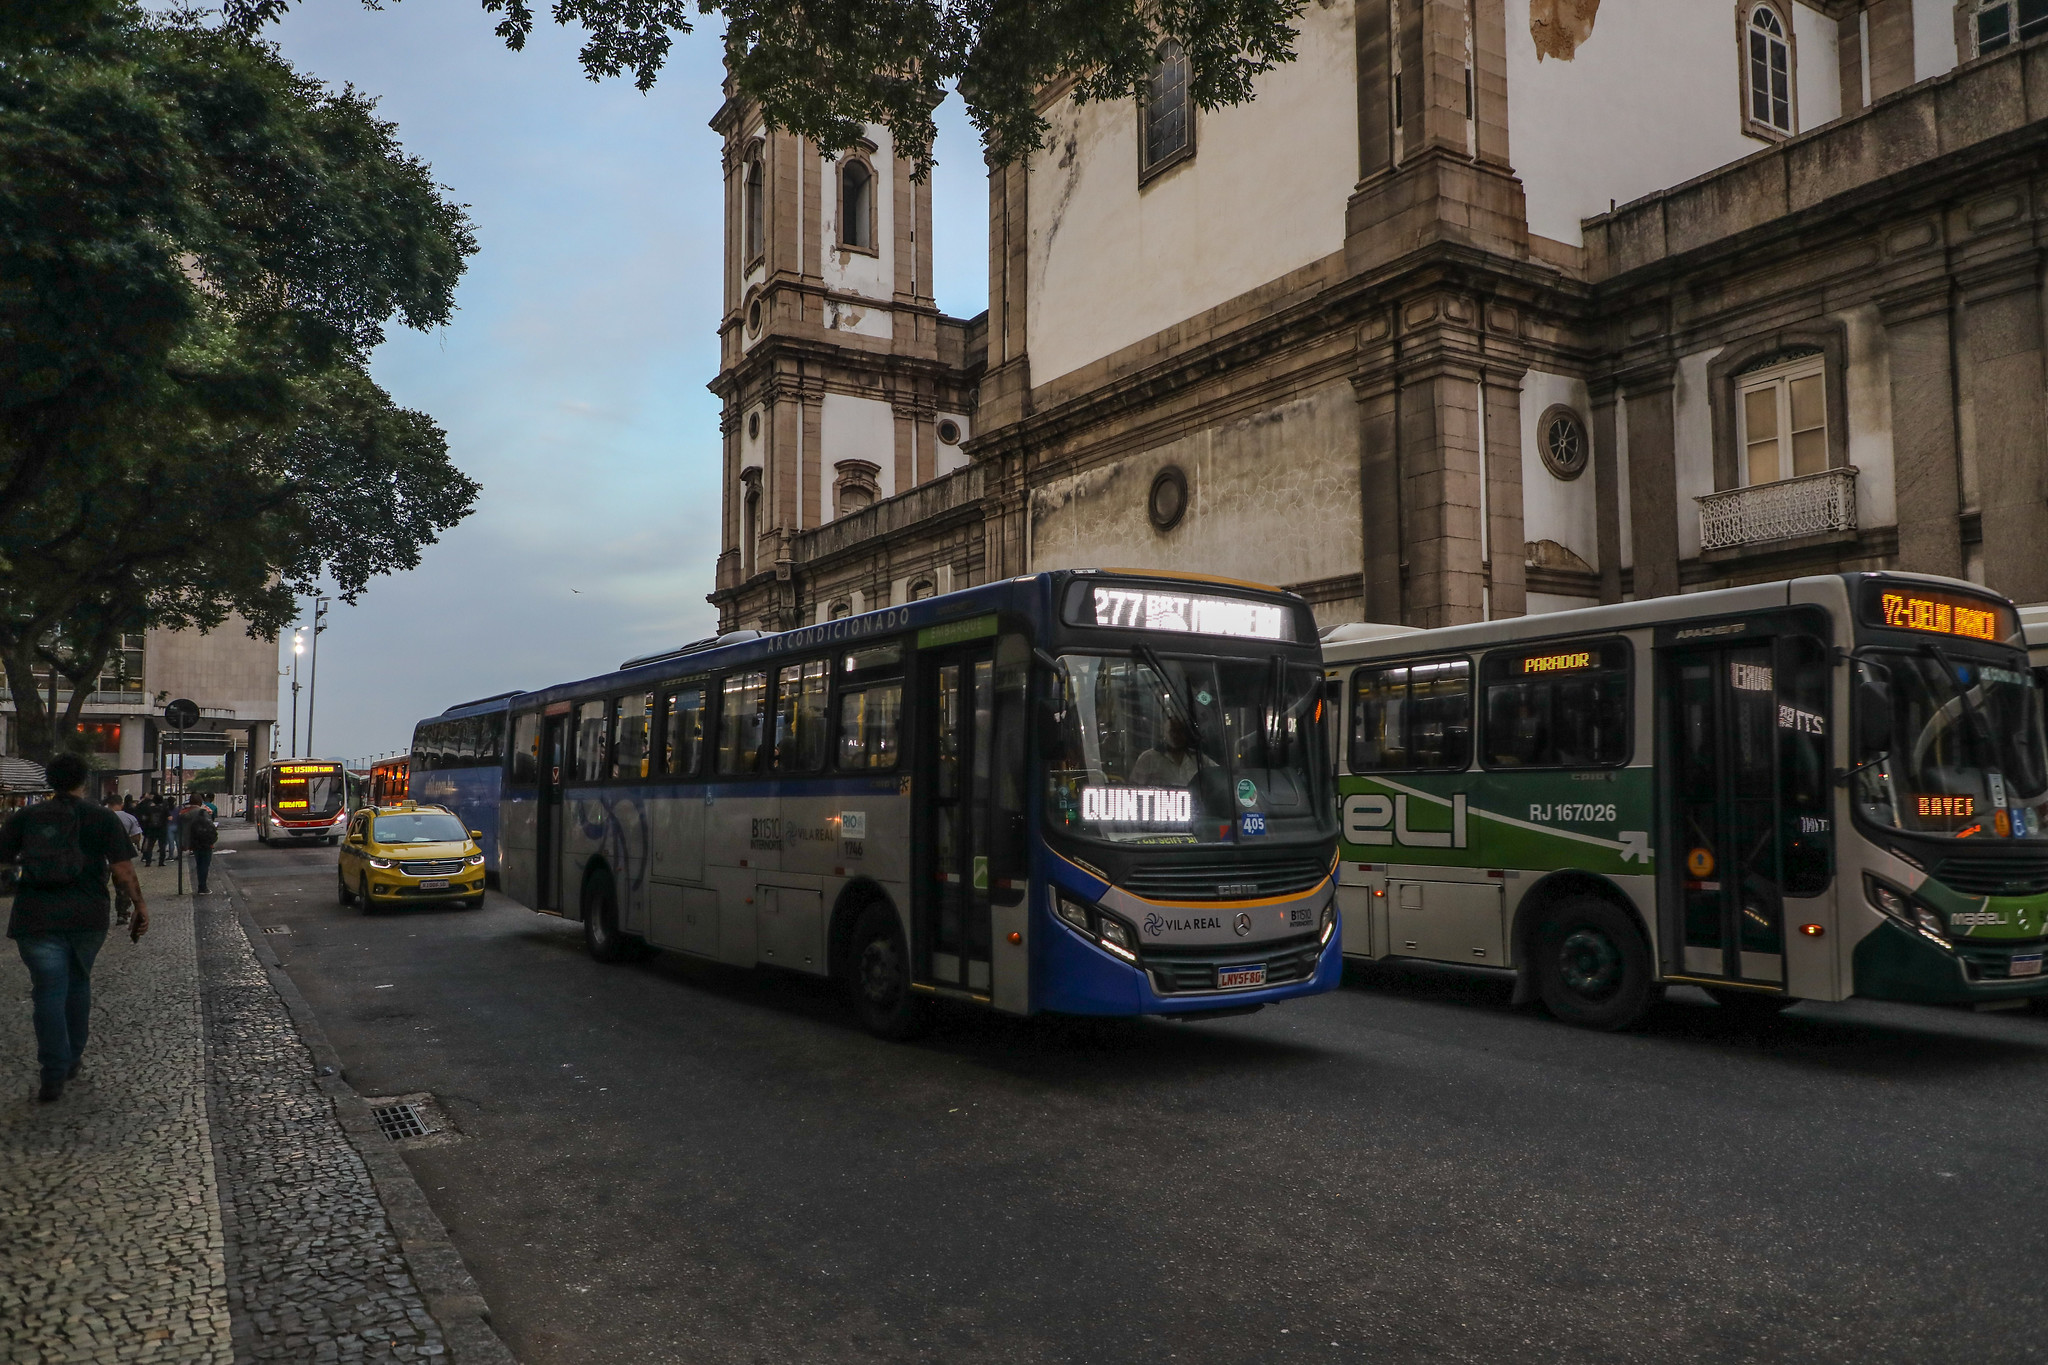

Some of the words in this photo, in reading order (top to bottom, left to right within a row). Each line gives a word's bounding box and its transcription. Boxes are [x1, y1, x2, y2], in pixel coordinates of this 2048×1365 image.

[1094, 587, 1144, 627] 277
[767, 636, 783, 653] AR
[786, 607, 909, 649] CONDICIONADO
[931, 617, 983, 639] EMBARQUE
[1524, 652, 1590, 673] PARADOR
[280, 766, 294, 774] 415
[294, 765, 318, 773] USINA
[1083, 787, 1192, 822] QUINTINO
[1529, 804, 1552, 822] RJ
[1555, 803, 1617, 823] 167.026
[751, 817, 781, 840] B11510
[842, 815, 858, 829] RIO
[1243, 818, 1265, 834] 4,05
[797, 828, 814, 841] VILA
[815, 829, 835, 842] REAL
[844, 841, 863, 857] 1746
[1165, 919, 1192, 931] VILA
[1194, 917, 1221, 930] REAL
